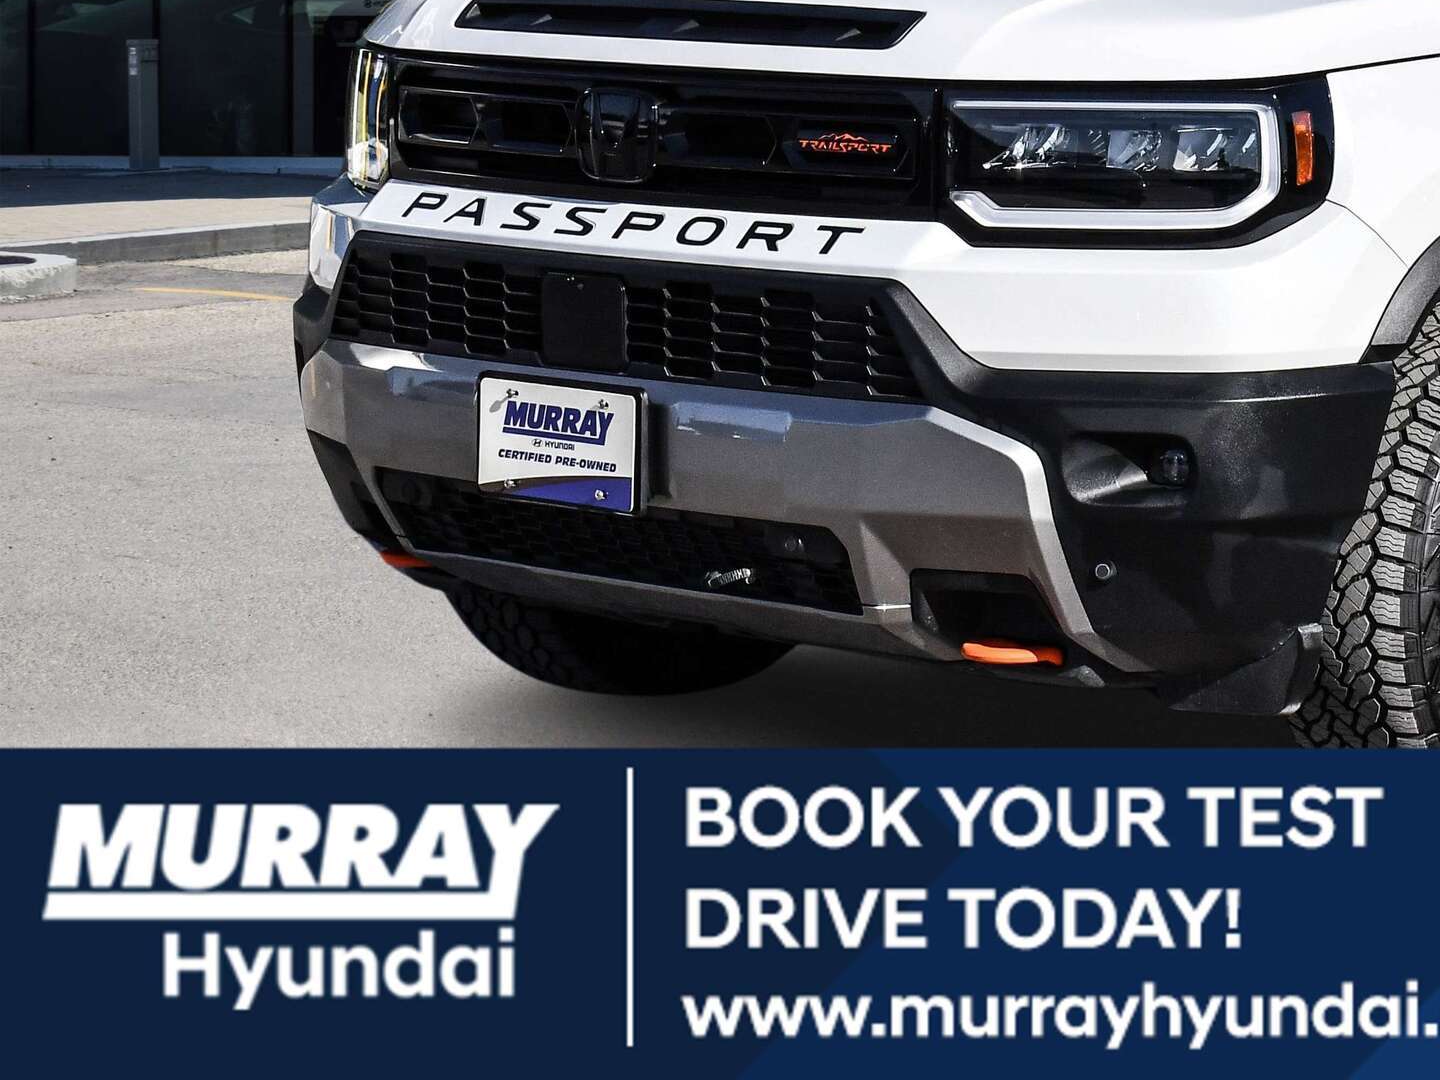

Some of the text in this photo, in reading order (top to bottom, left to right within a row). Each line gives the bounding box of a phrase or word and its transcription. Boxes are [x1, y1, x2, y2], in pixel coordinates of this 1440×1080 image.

[798, 139, 892, 155] TRAILSPORT
[401, 192, 866, 255] PASSPORT
[503, 400, 615, 446] MURRAY
[544, 440, 575, 451] HYUNDAI
[498, 448, 617, 473] CERTIFIED PRE-OWNED
